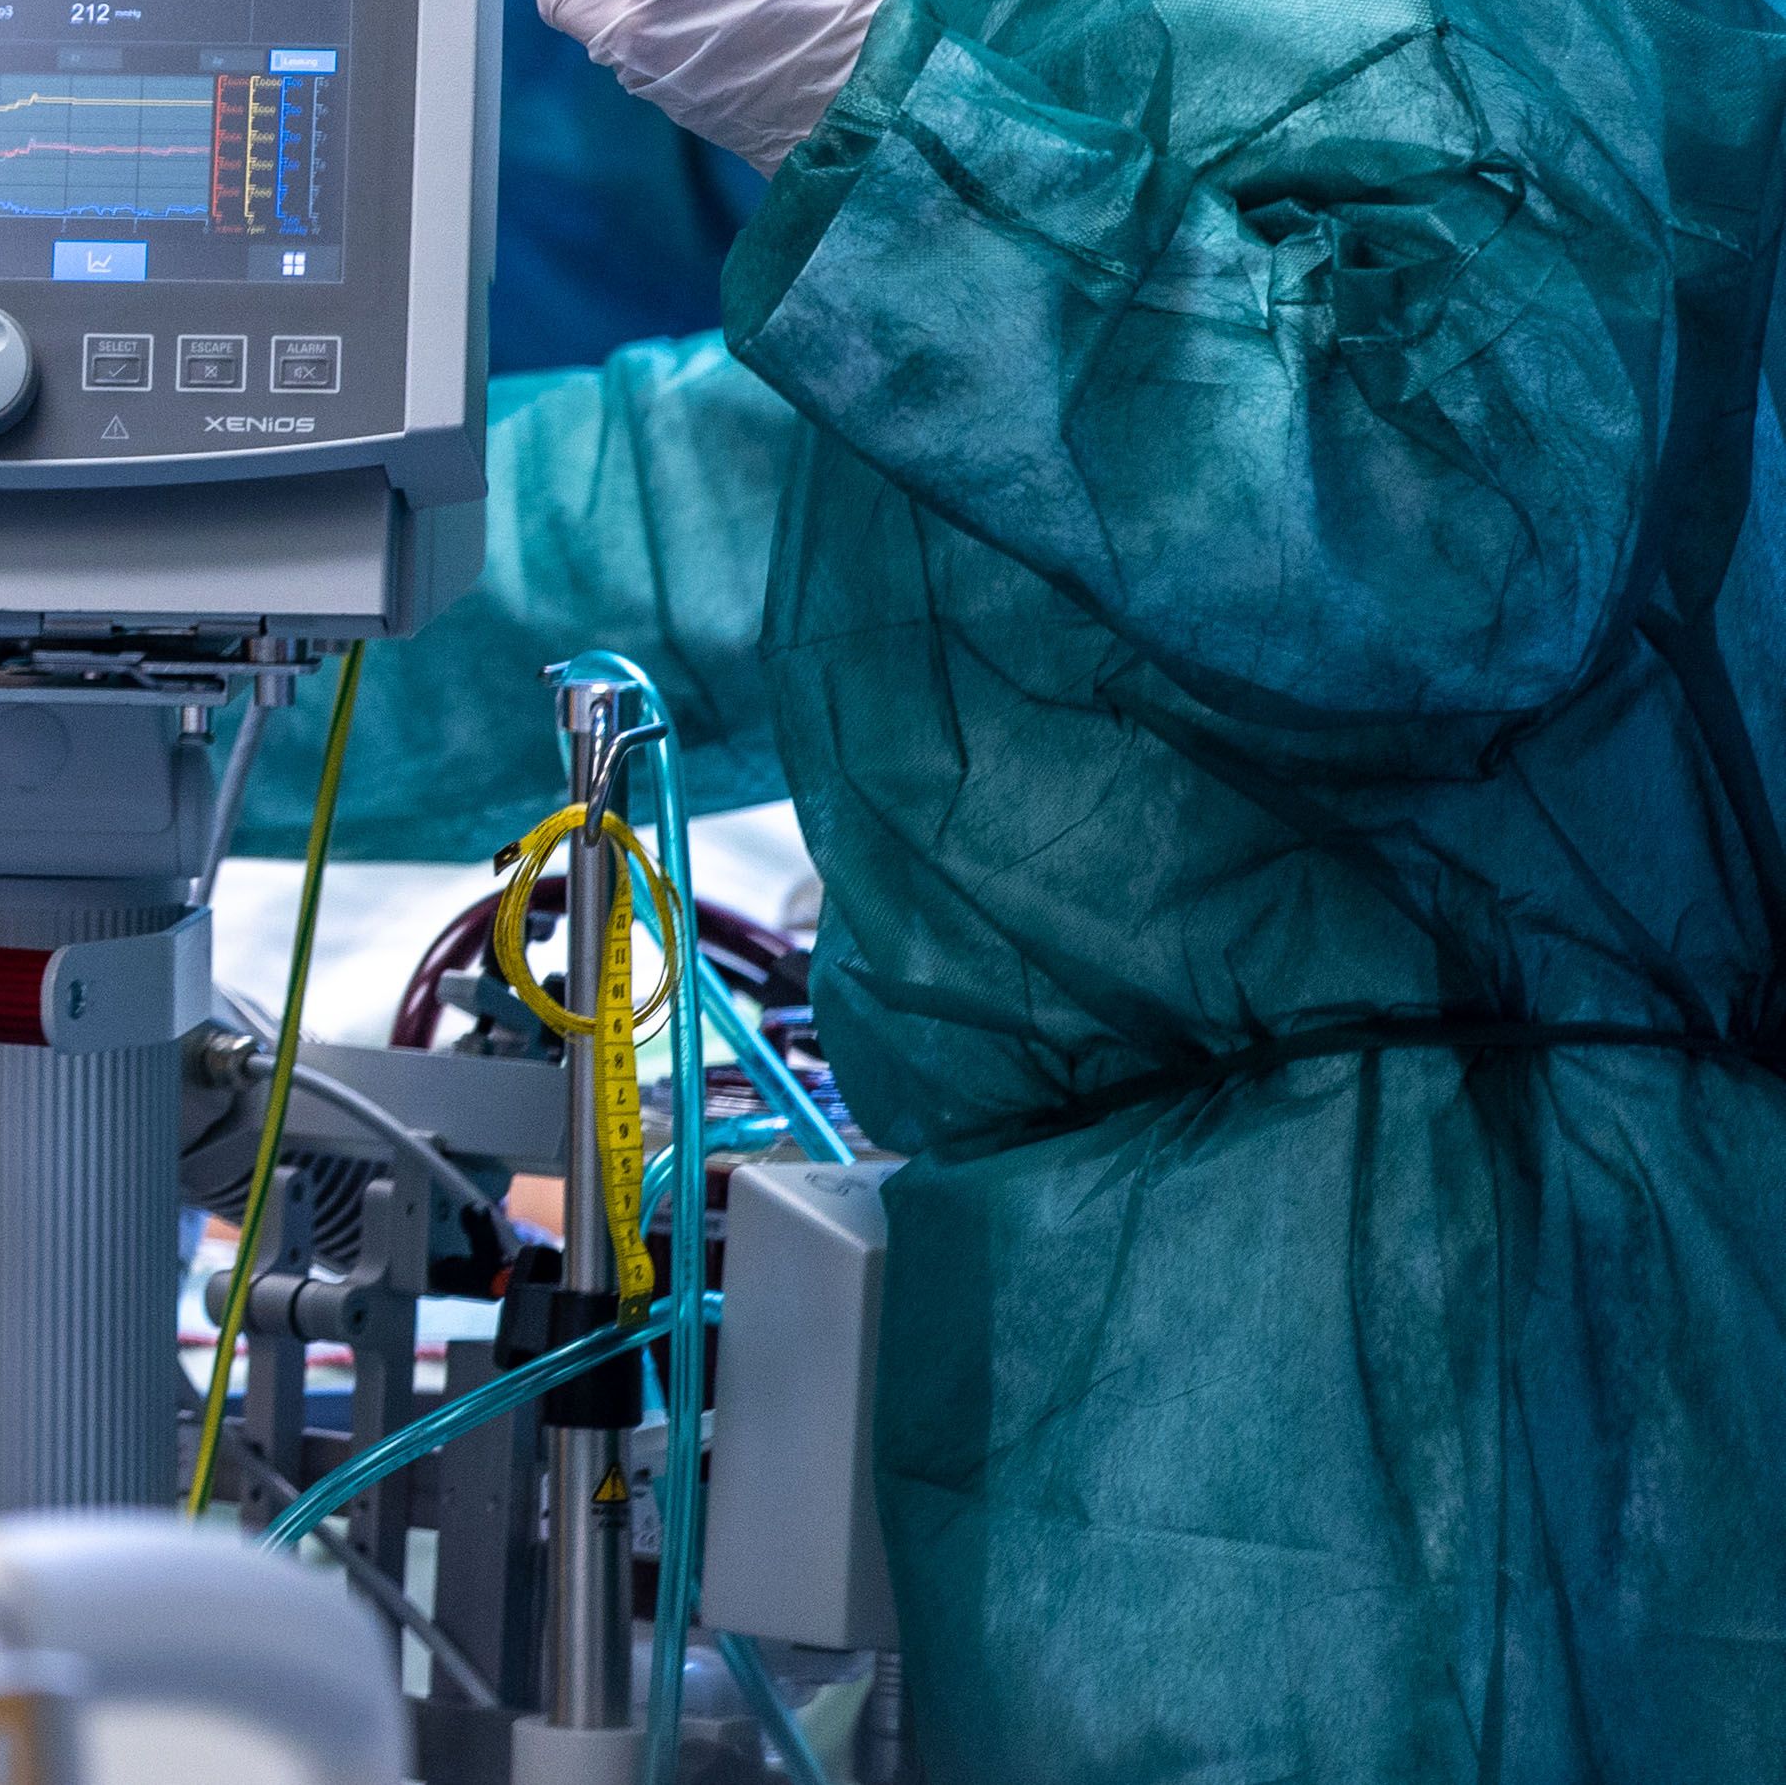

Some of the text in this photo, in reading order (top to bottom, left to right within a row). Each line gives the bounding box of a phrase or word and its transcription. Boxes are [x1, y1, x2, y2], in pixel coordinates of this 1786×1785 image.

[70, 3, 111, 24] 212
[98, 341, 138, 353] SELECT
[190, 342, 234, 354] ESCAPE
[286, 342, 327, 354] ALARM
[616, 1087, 627, 1105] 7
[634, 1264, 645, 1281] 2
